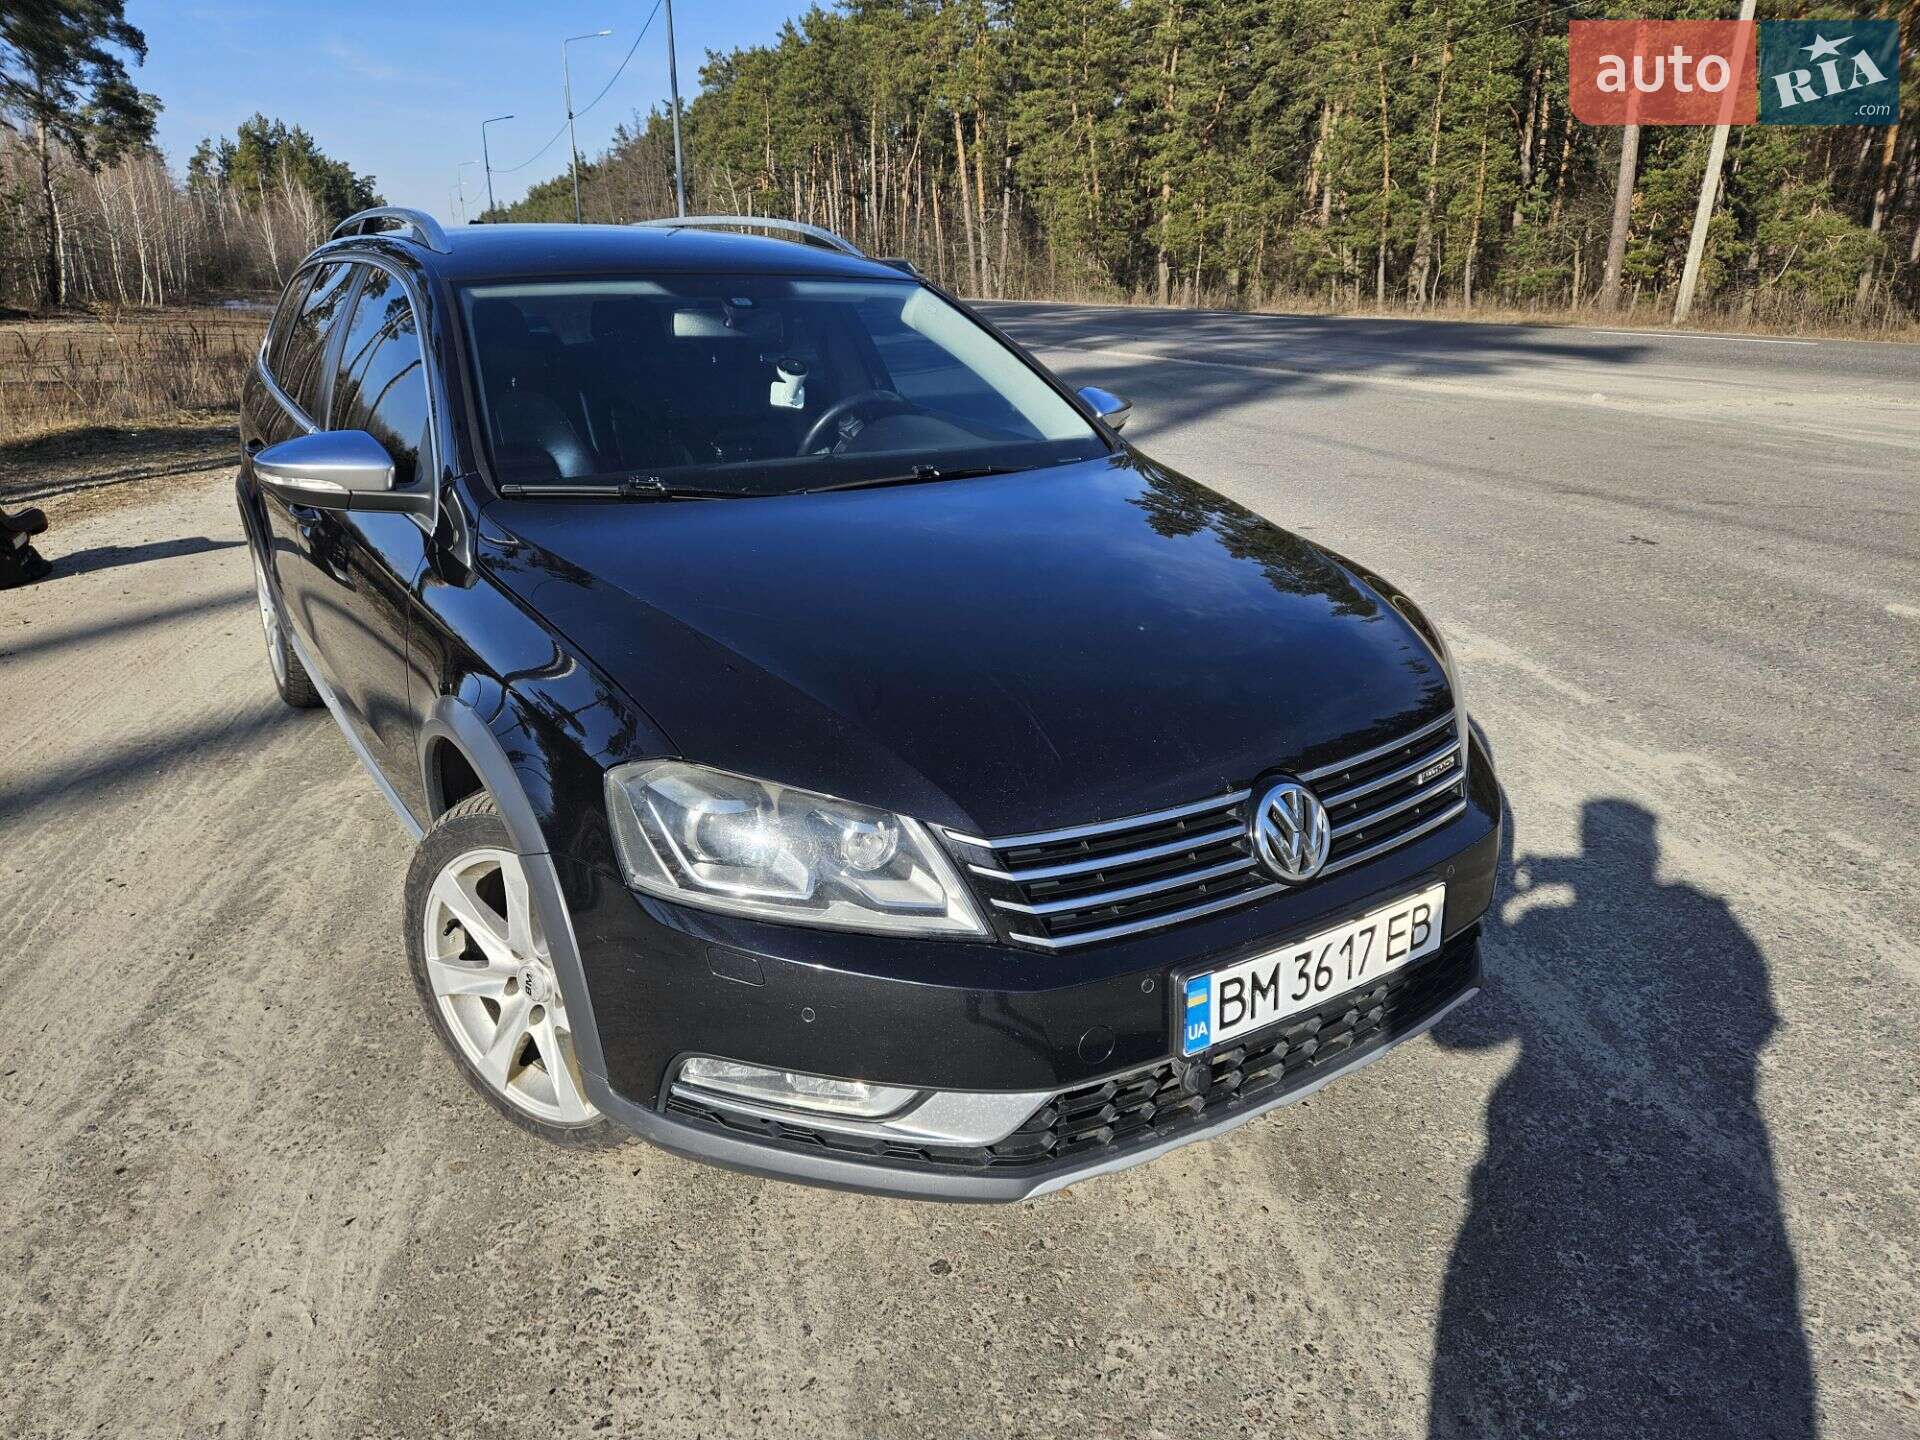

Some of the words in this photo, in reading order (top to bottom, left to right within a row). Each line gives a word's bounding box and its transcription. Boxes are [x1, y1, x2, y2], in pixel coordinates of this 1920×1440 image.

[1219, 962, 1280, 1030] BM
[1291, 924, 1377, 1002] 3617
[1385, 903, 1432, 963] EB
[1188, 1022, 1208, 1041] UA
